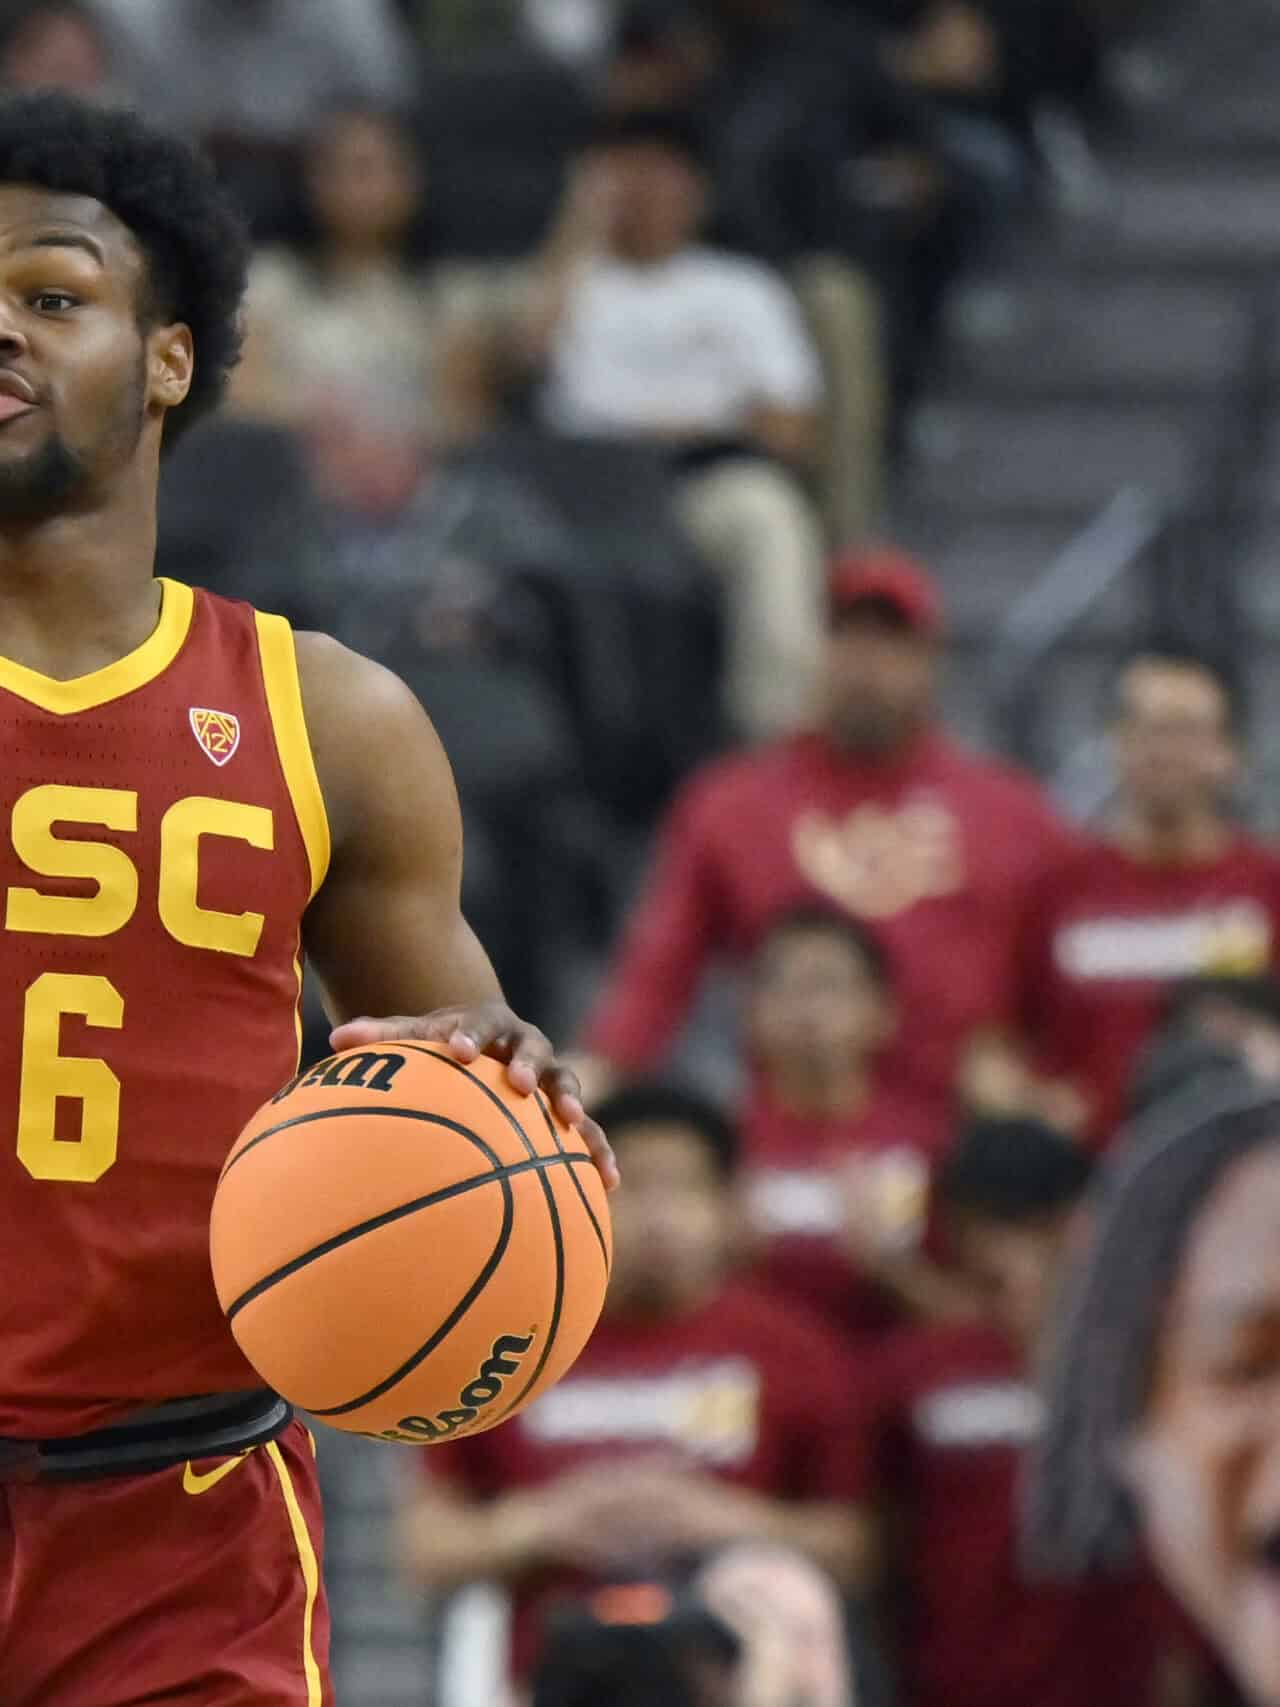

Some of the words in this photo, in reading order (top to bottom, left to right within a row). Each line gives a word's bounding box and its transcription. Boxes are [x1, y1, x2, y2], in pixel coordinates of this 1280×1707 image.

[194, 711, 236, 744] PAC
[206, 733, 228, 752] 12
[17, 972, 124, 1183] 6
